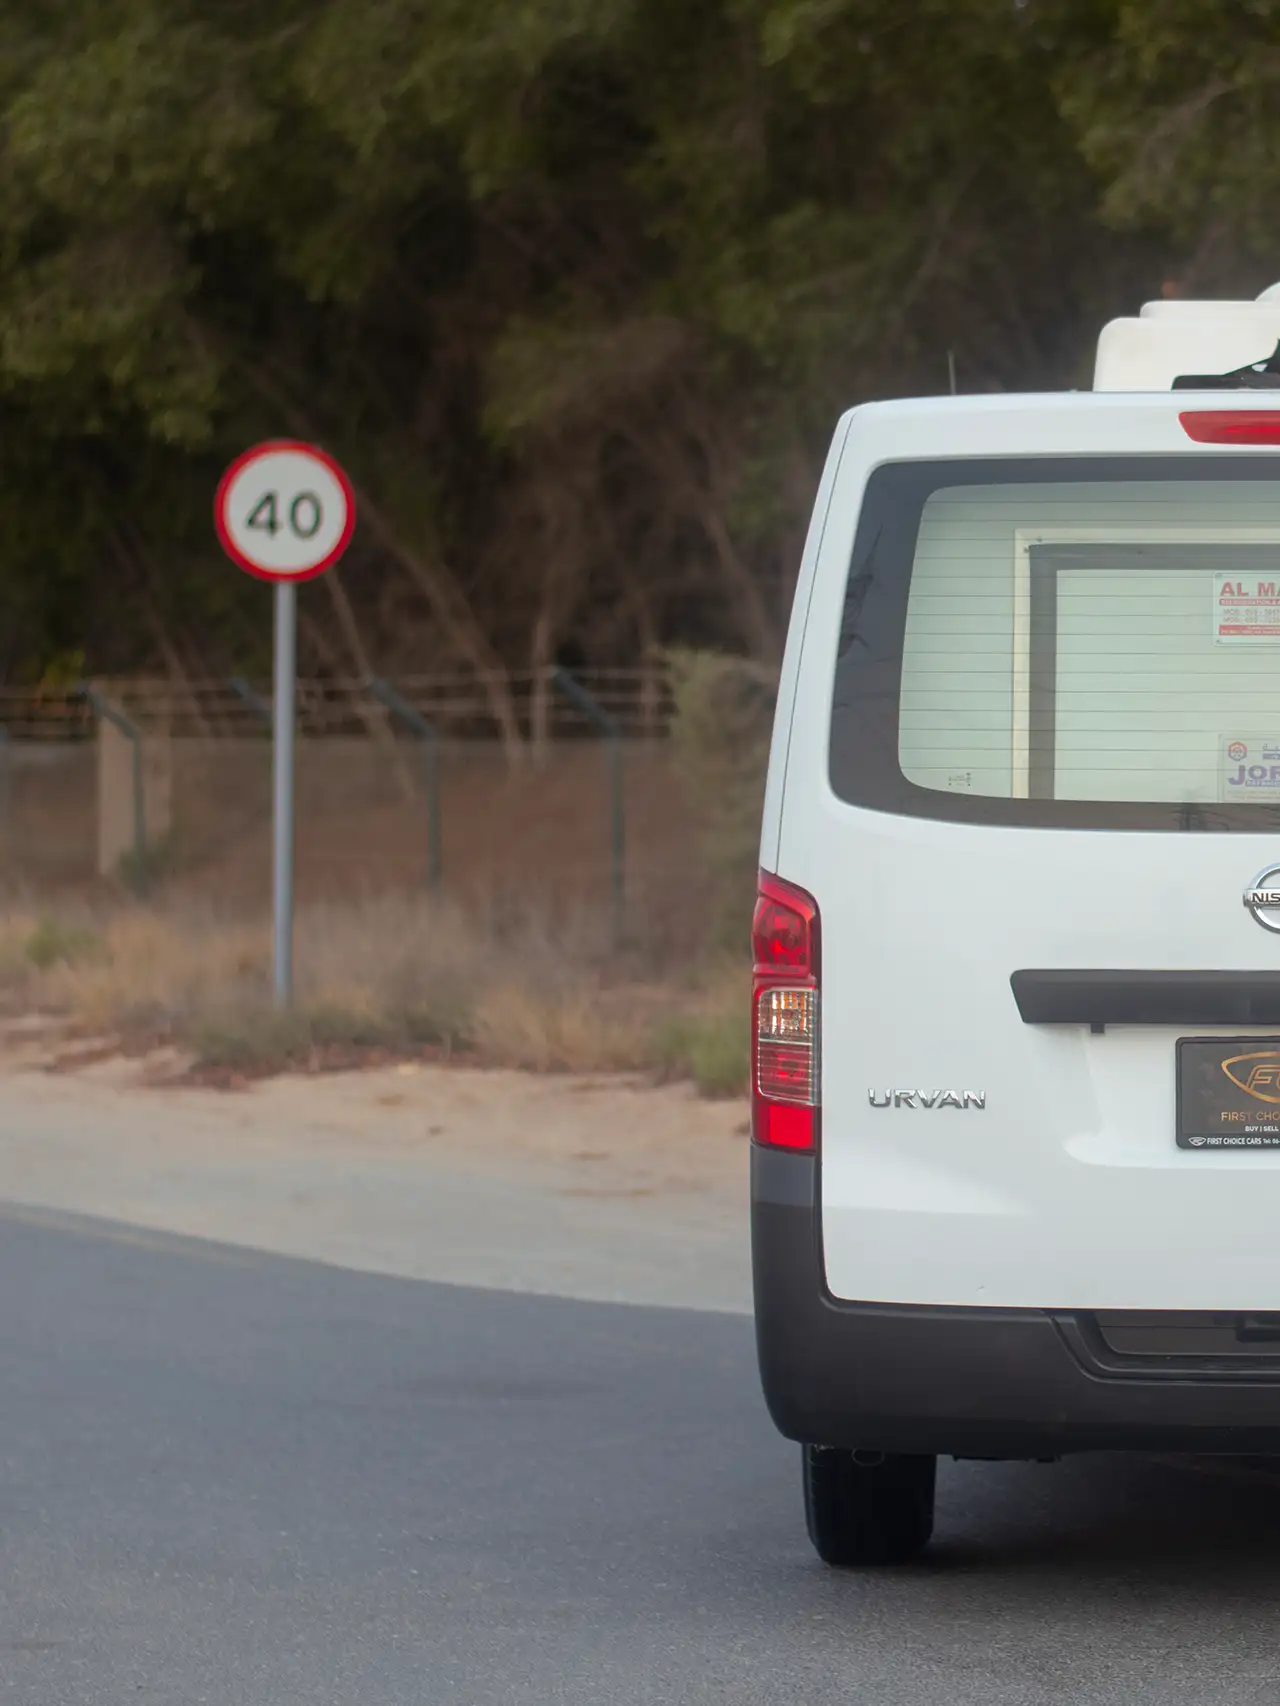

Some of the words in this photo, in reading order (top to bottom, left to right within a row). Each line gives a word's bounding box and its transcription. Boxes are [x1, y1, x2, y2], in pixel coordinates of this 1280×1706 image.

[246, 490, 323, 541] 40
[1220, 582, 1249, 597] AL
[868, 1088, 986, 1109] URVAN
[1221, 1111, 1252, 1122] FIRST
[1207, 1137, 1222, 1145] FIRST
[1223, 1137, 1245, 1145] CHOICE
[1246, 1137, 1262, 1145] CARS
